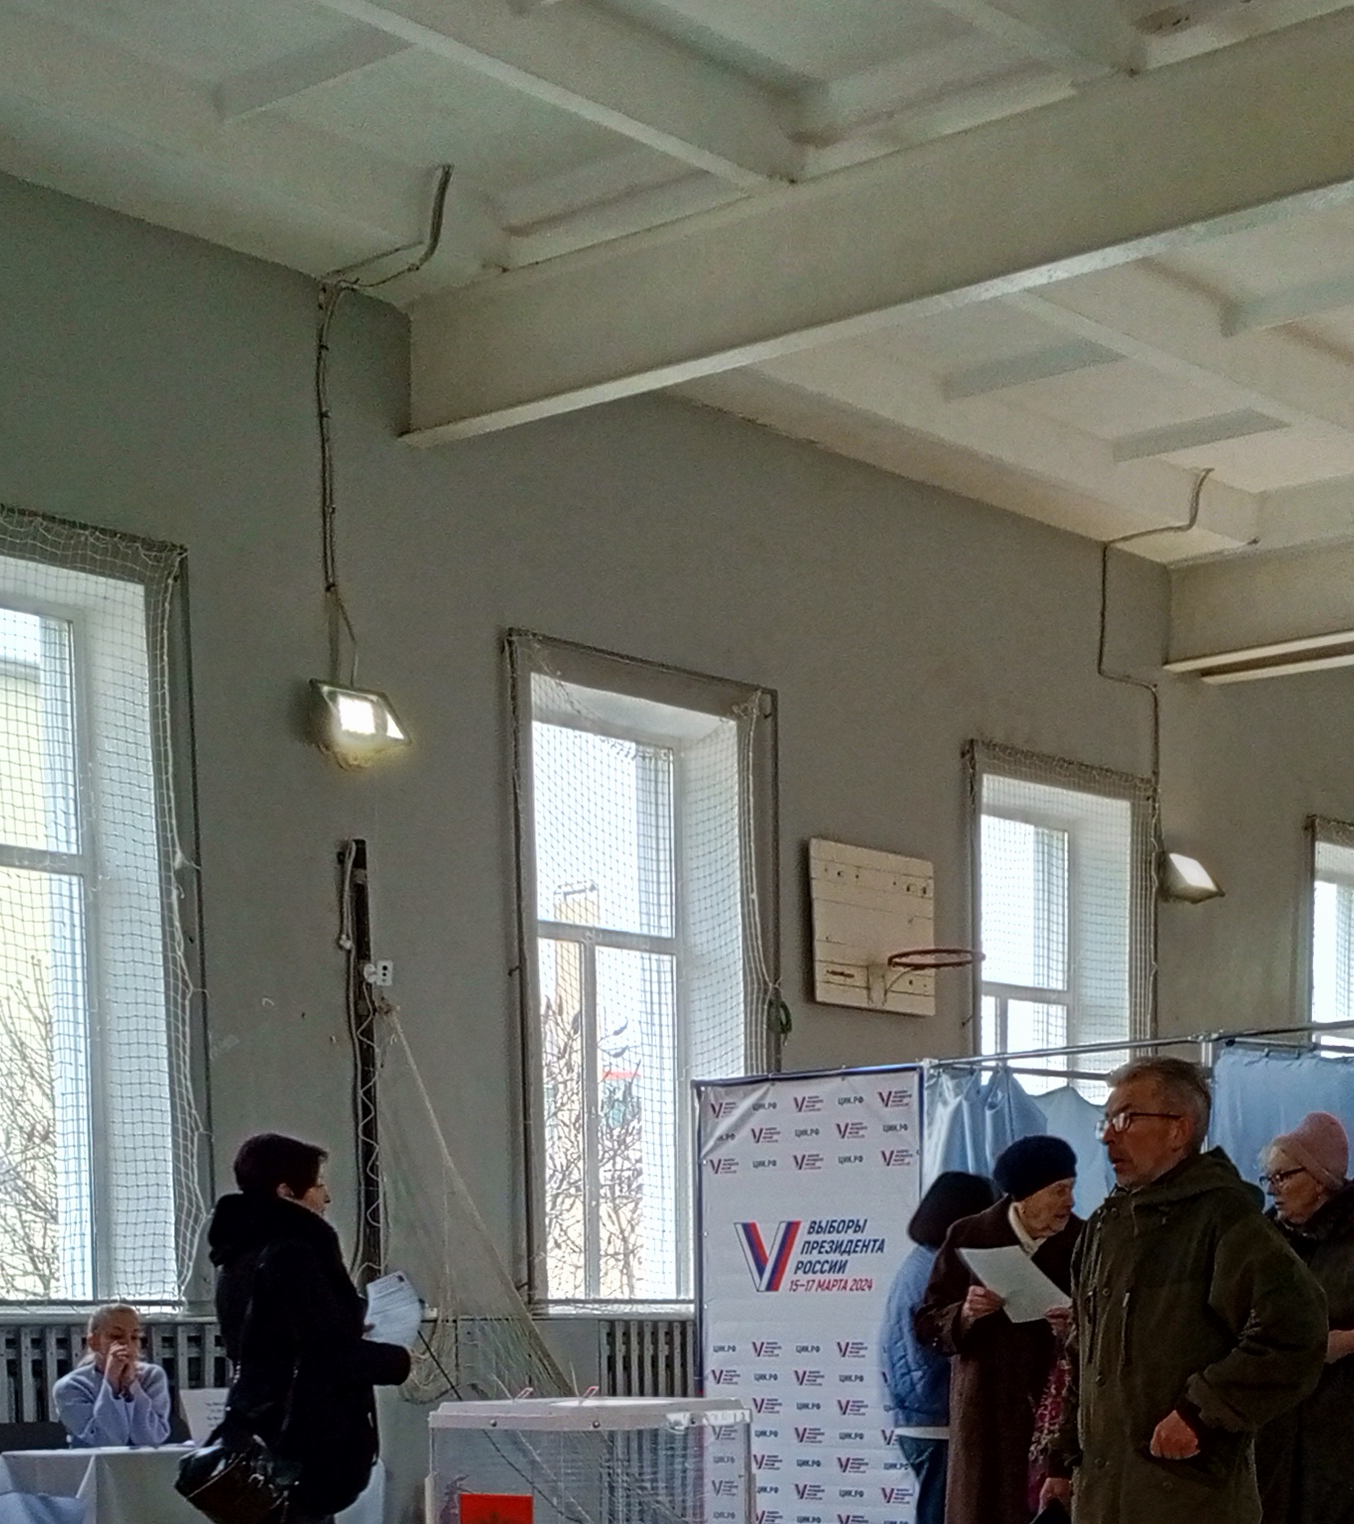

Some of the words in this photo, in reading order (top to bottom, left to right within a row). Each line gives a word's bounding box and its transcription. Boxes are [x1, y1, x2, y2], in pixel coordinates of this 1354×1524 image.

[806, 1219, 868, 1235] ВЫБОРЫ
[800, 1238, 885, 1257] ПРЕЗИДЕНТА
[793, 1260, 849, 1275] РОССИИ
[816, 1279, 848, 1292] МАРТА
[848, 1278, 873, 1292] 2024
